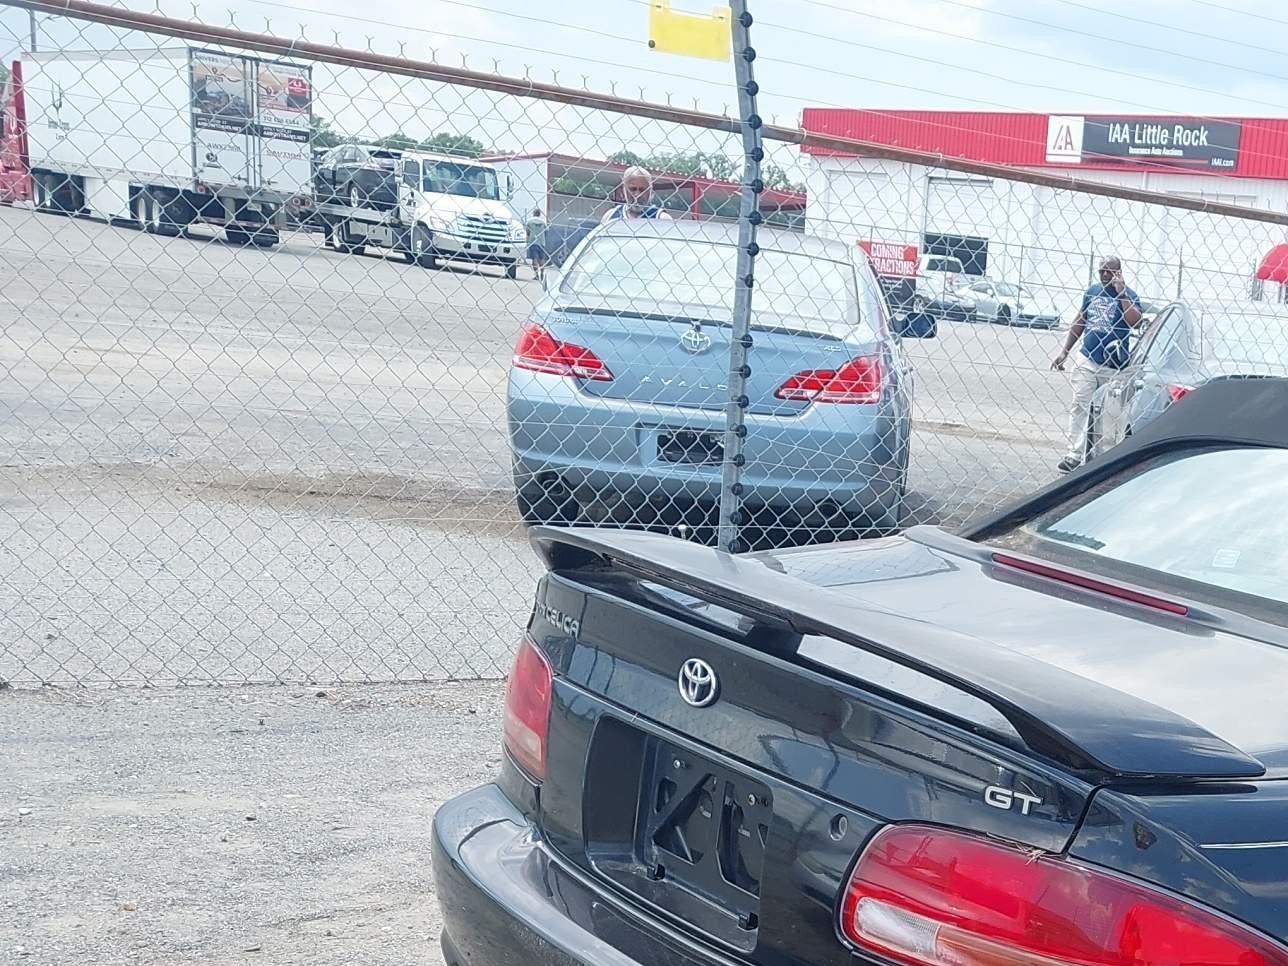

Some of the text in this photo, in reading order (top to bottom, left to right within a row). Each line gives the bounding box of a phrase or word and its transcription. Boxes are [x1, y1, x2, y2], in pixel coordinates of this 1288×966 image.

[1108, 122, 1209, 147] IAA Little Rock
[870, 243, 905, 260] COMING
[546, 606, 580, 641] CELICA
[984, 785, 1042, 815] GT
